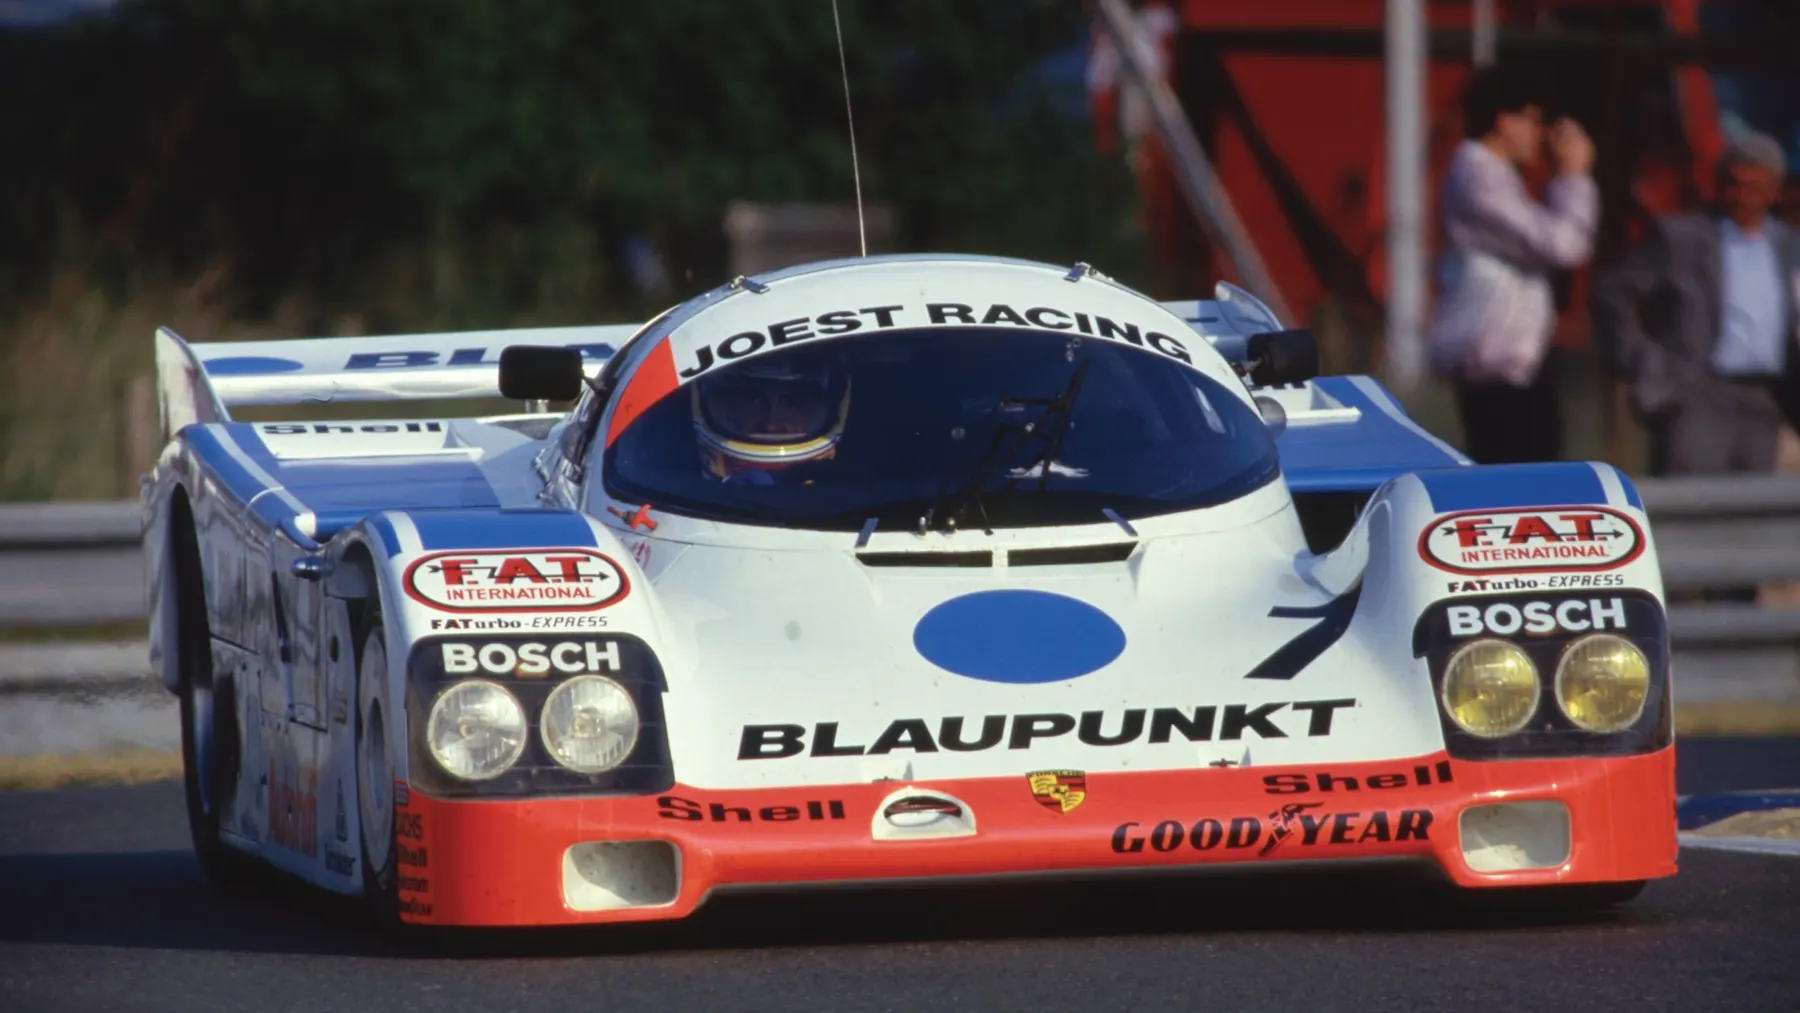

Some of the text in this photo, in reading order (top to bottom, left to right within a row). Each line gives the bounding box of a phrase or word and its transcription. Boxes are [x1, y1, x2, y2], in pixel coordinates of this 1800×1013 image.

[679, 302, 1194, 379] JOEST RACING
[263, 422, 442, 435] Shell
[1461, 544, 1610, 563] INTERNATIONAL
[446, 586, 596, 601] INTERNATIONAL
[1243, 581, 1364, 680] 7
[1447, 598, 1627, 636] BOSCH
[441, 641, 621, 674] BOSCH
[737, 698, 1357, 760] BLAUPUNKT
[1262, 760, 1453, 794] Shell
[657, 795, 846, 823] Shell
